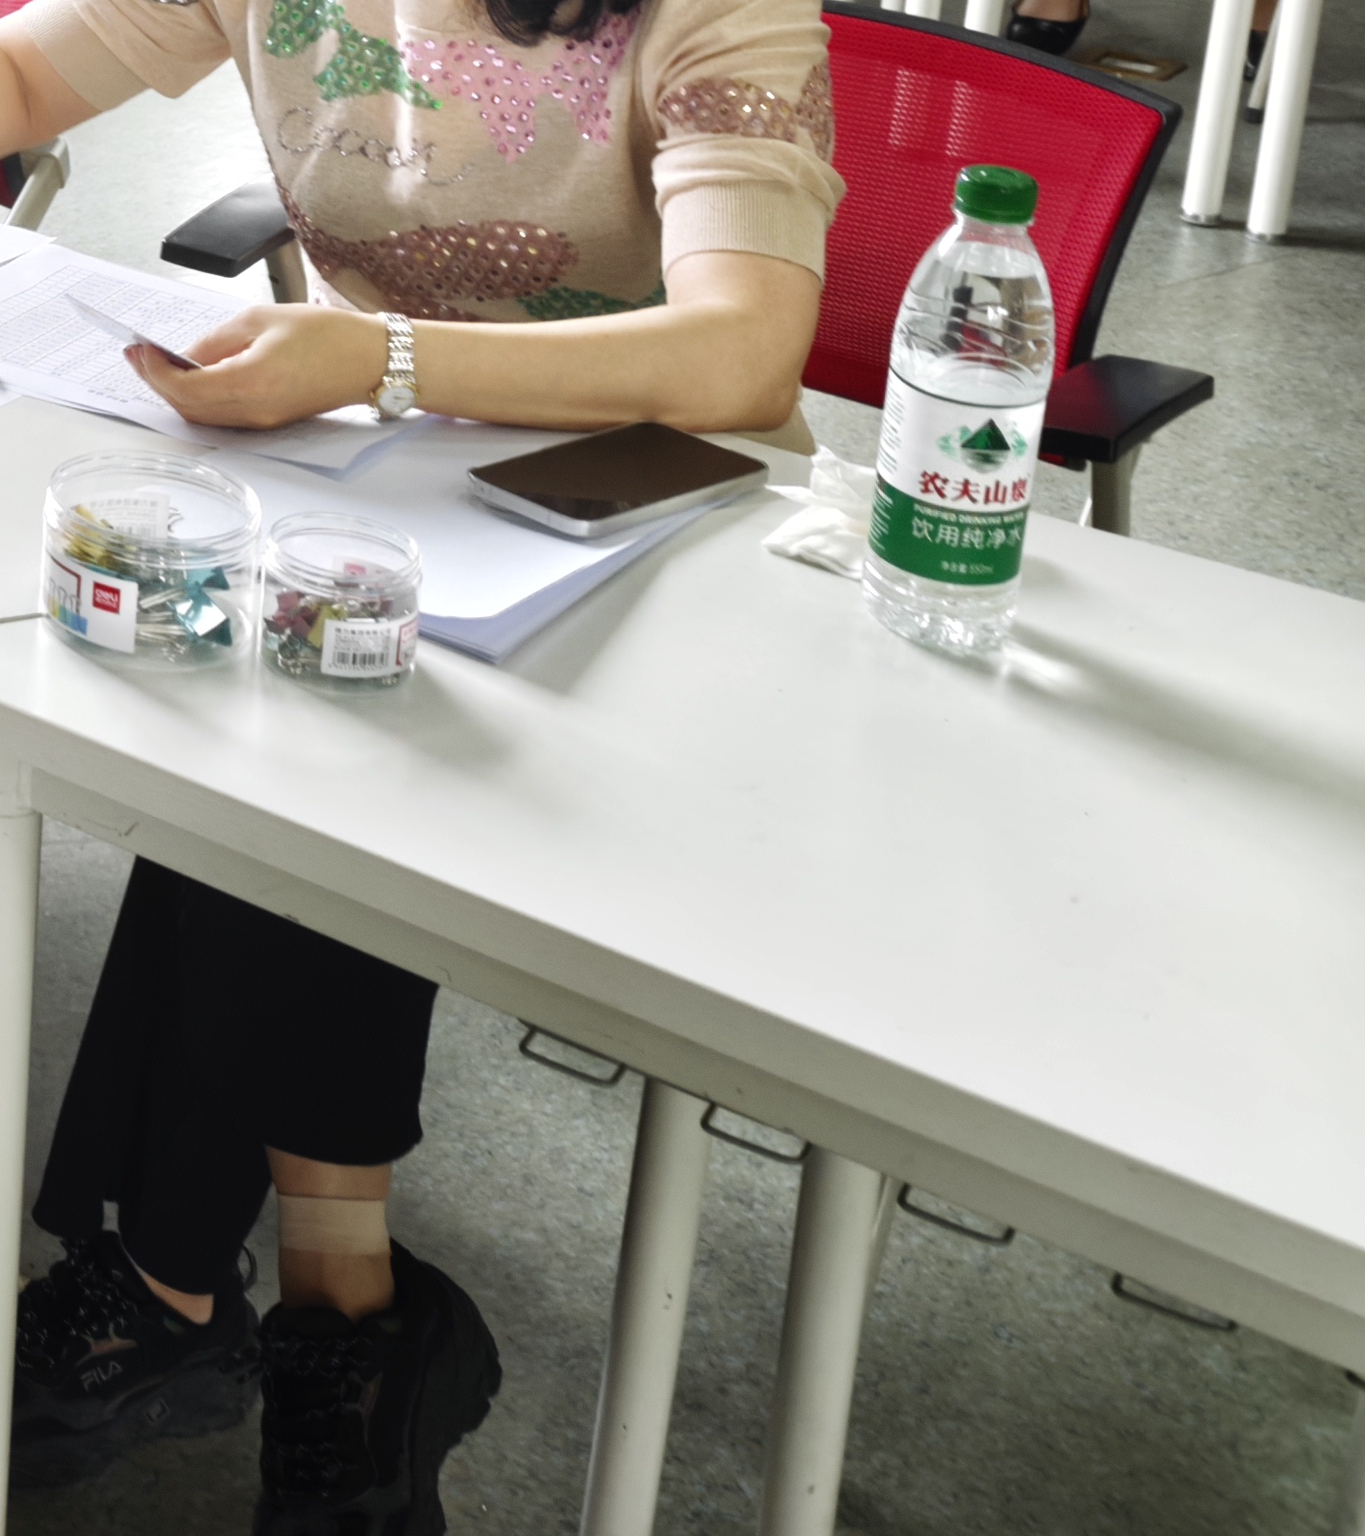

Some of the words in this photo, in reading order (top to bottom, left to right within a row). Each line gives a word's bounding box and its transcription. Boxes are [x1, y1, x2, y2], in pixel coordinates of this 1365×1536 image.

[918, 470, 1028, 505] 农夫山泉
[911, 515, 1021, 550] 饮用纯净水
[80, 1361, 124, 1393] FILA
